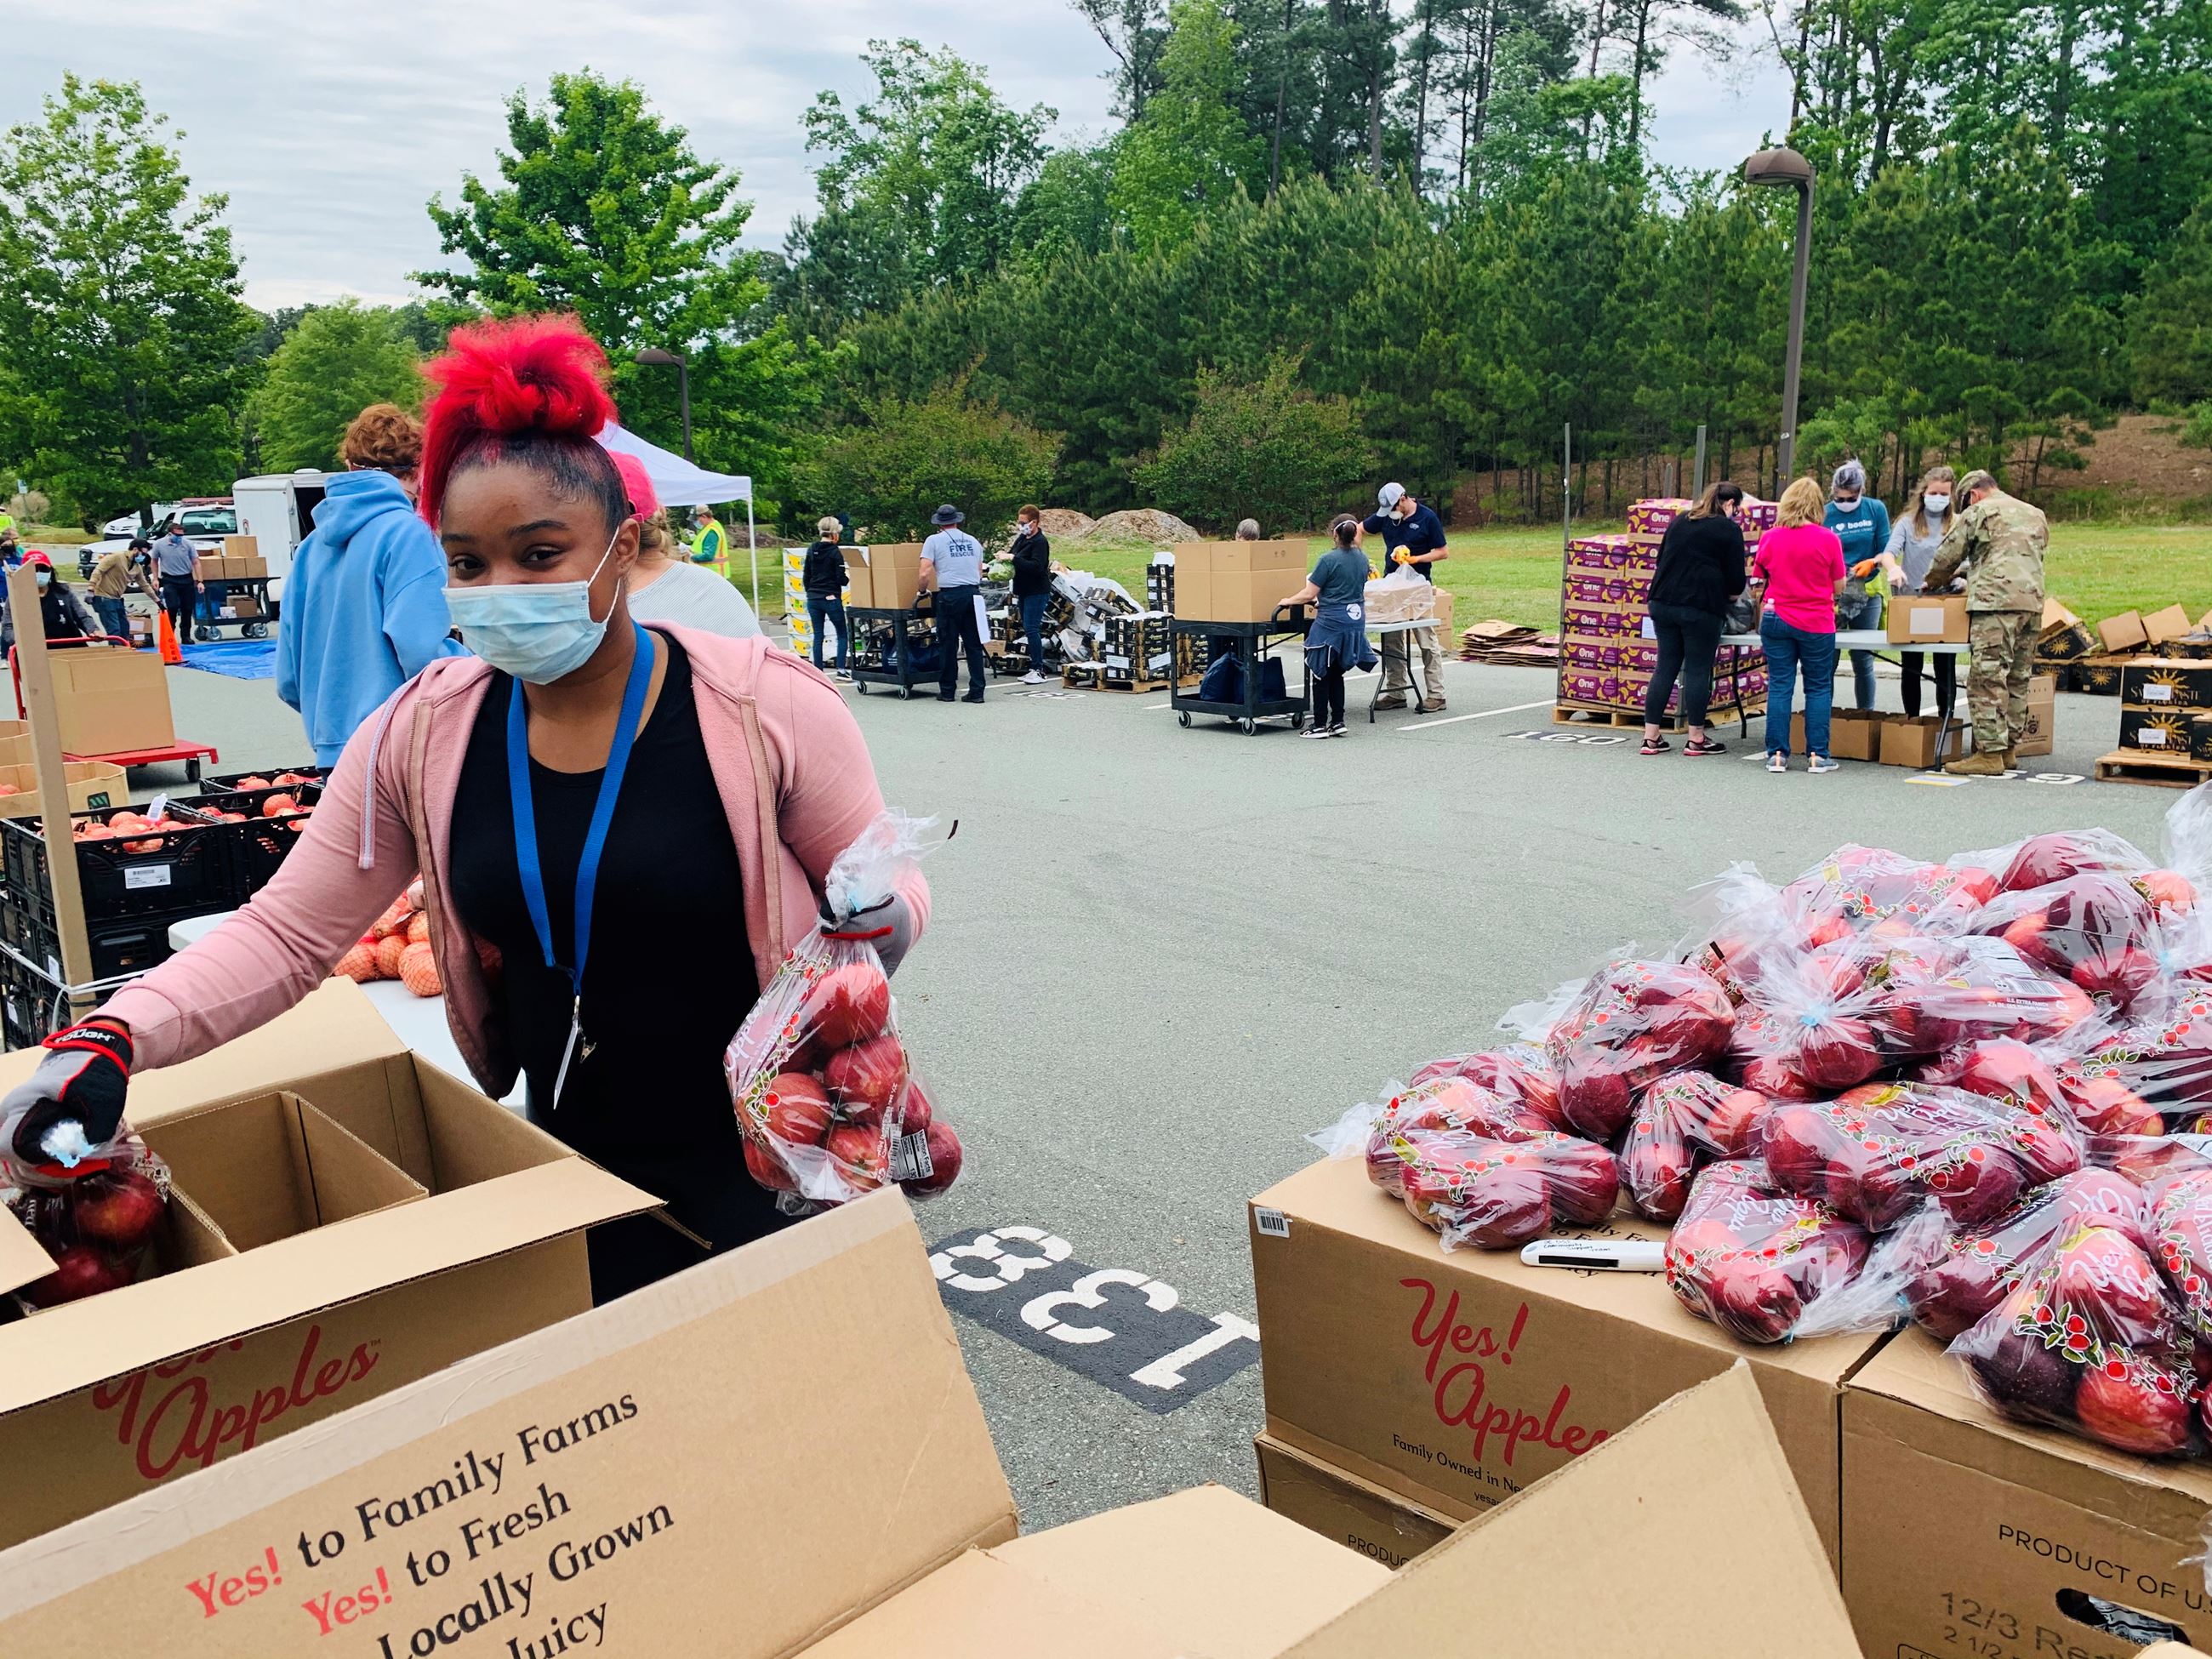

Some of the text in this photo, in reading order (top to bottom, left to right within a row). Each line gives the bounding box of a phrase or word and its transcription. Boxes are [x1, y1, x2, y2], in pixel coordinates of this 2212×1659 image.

[1651, 512, 1670, 523] One
[1847, 520, 1873, 529] books
[949, 544, 974, 552] FIRE
[1581, 614, 1597, 625] One
[1578, 647, 1595, 658] One
[1578, 678, 1594, 689] One
[1507, 731, 1627, 745] 160
[919, 1131, 927, 1156] Nutrition
[1549, 1227, 1569, 1236] to
[928, 1225, 1260, 1389] 138
[1400, 1277, 1529, 1384] Yes!
[136, 1325, 379, 1479] Apples
[1393, 1434, 1525, 1494] Family Owned in Ne
[184, 1391, 639, 1620] Yes! to Family Farms
[302, 1483, 572, 1638] Yes! to Fresh
[377, 1500, 676, 1659] Locally Grown
[1999, 1525, 2131, 1583] PRODUCT
[2136, 1575, 2176, 1599] OF
[505, 1599, 610, 1659] Juicy
[1941, 1593, 2019, 1640] 12/3
